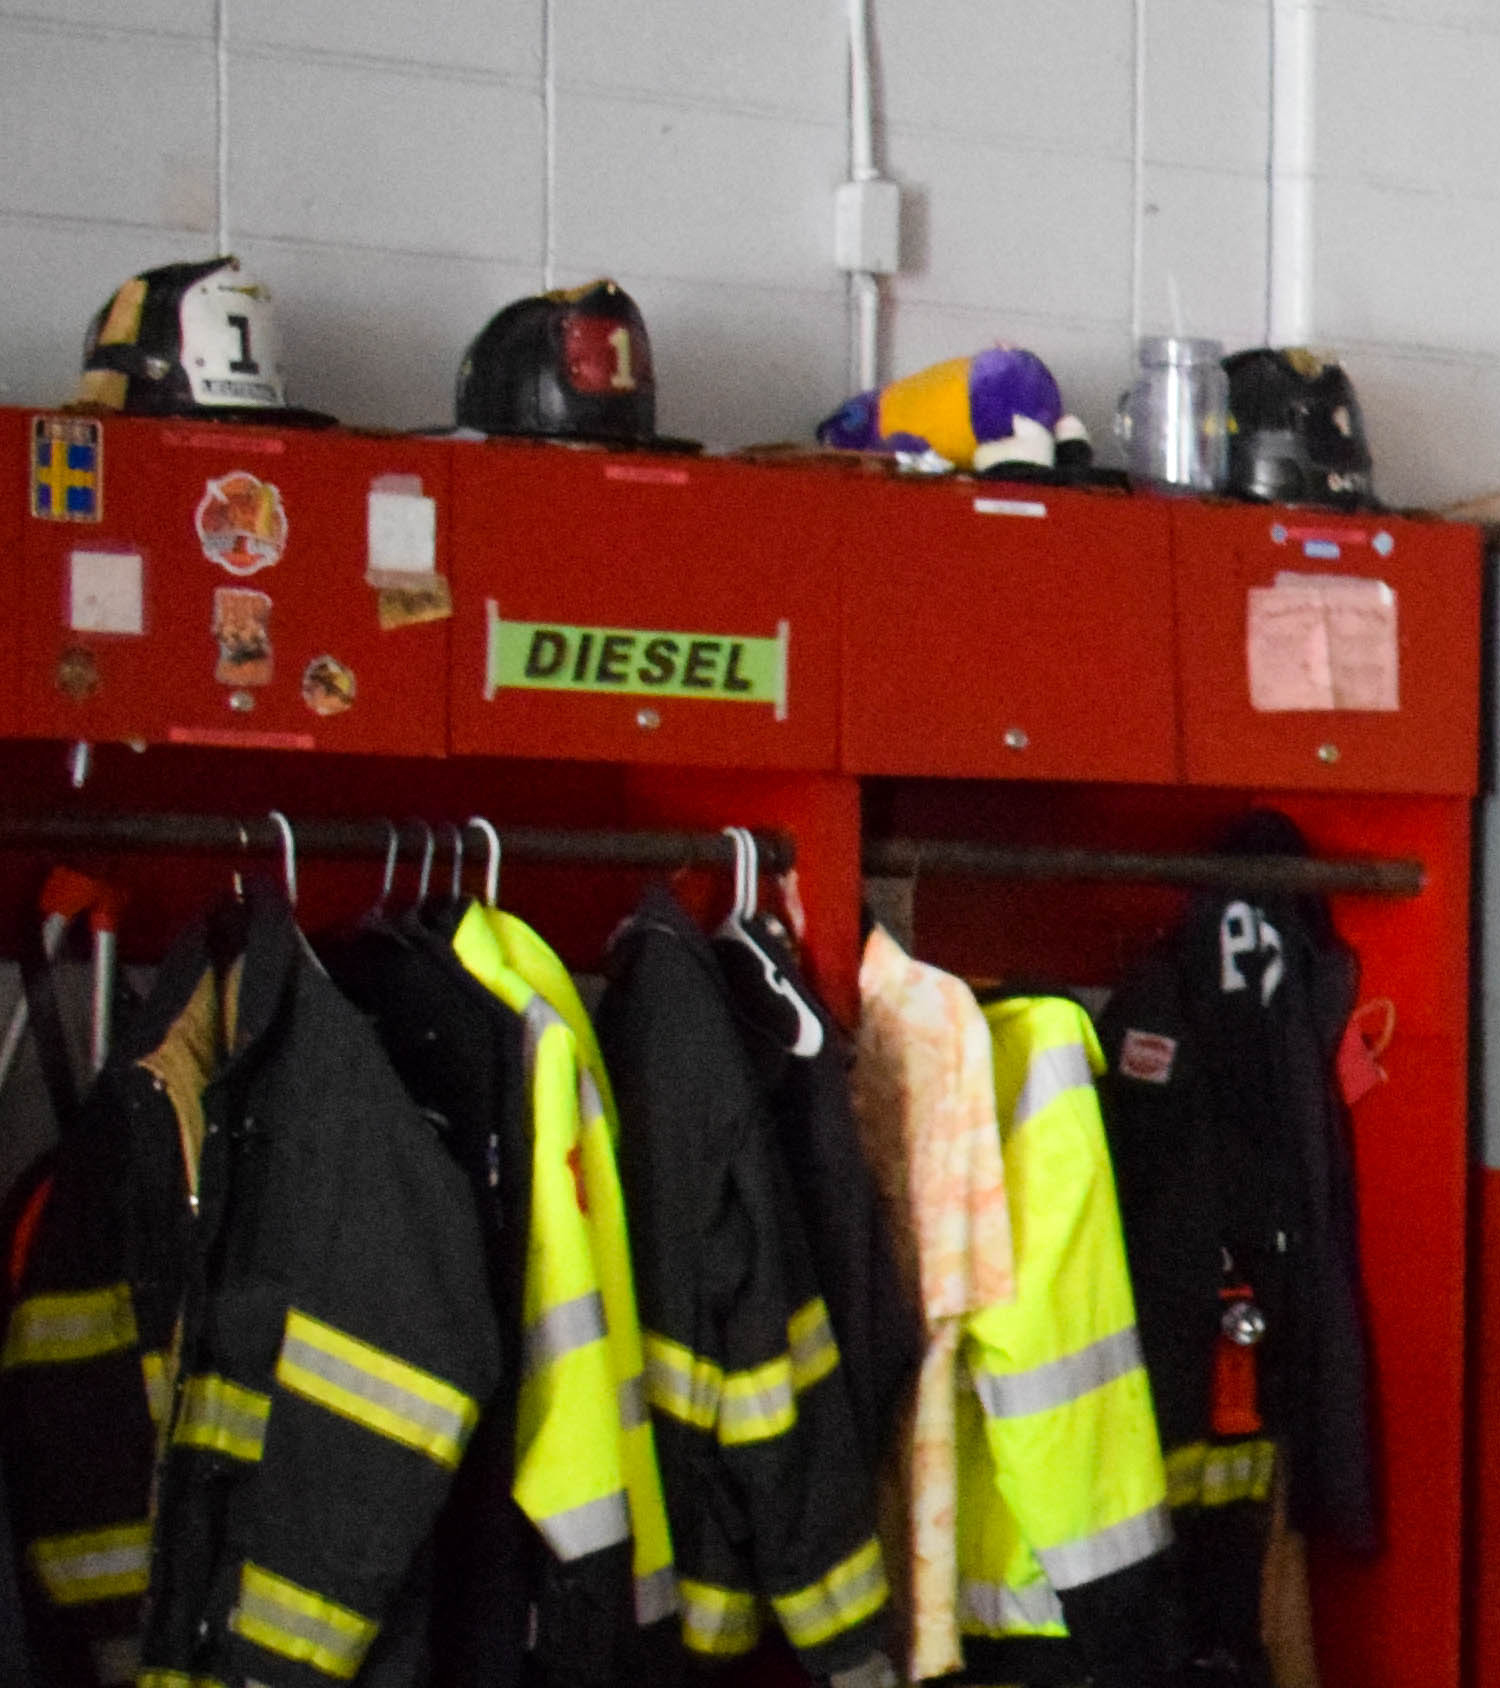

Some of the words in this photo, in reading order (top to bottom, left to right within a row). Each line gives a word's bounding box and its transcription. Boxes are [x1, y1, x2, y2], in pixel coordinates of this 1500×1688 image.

[227, 314, 259, 375] 1
[608, 328, 636, 389] 1
[524, 629, 753, 692] DIESEL
